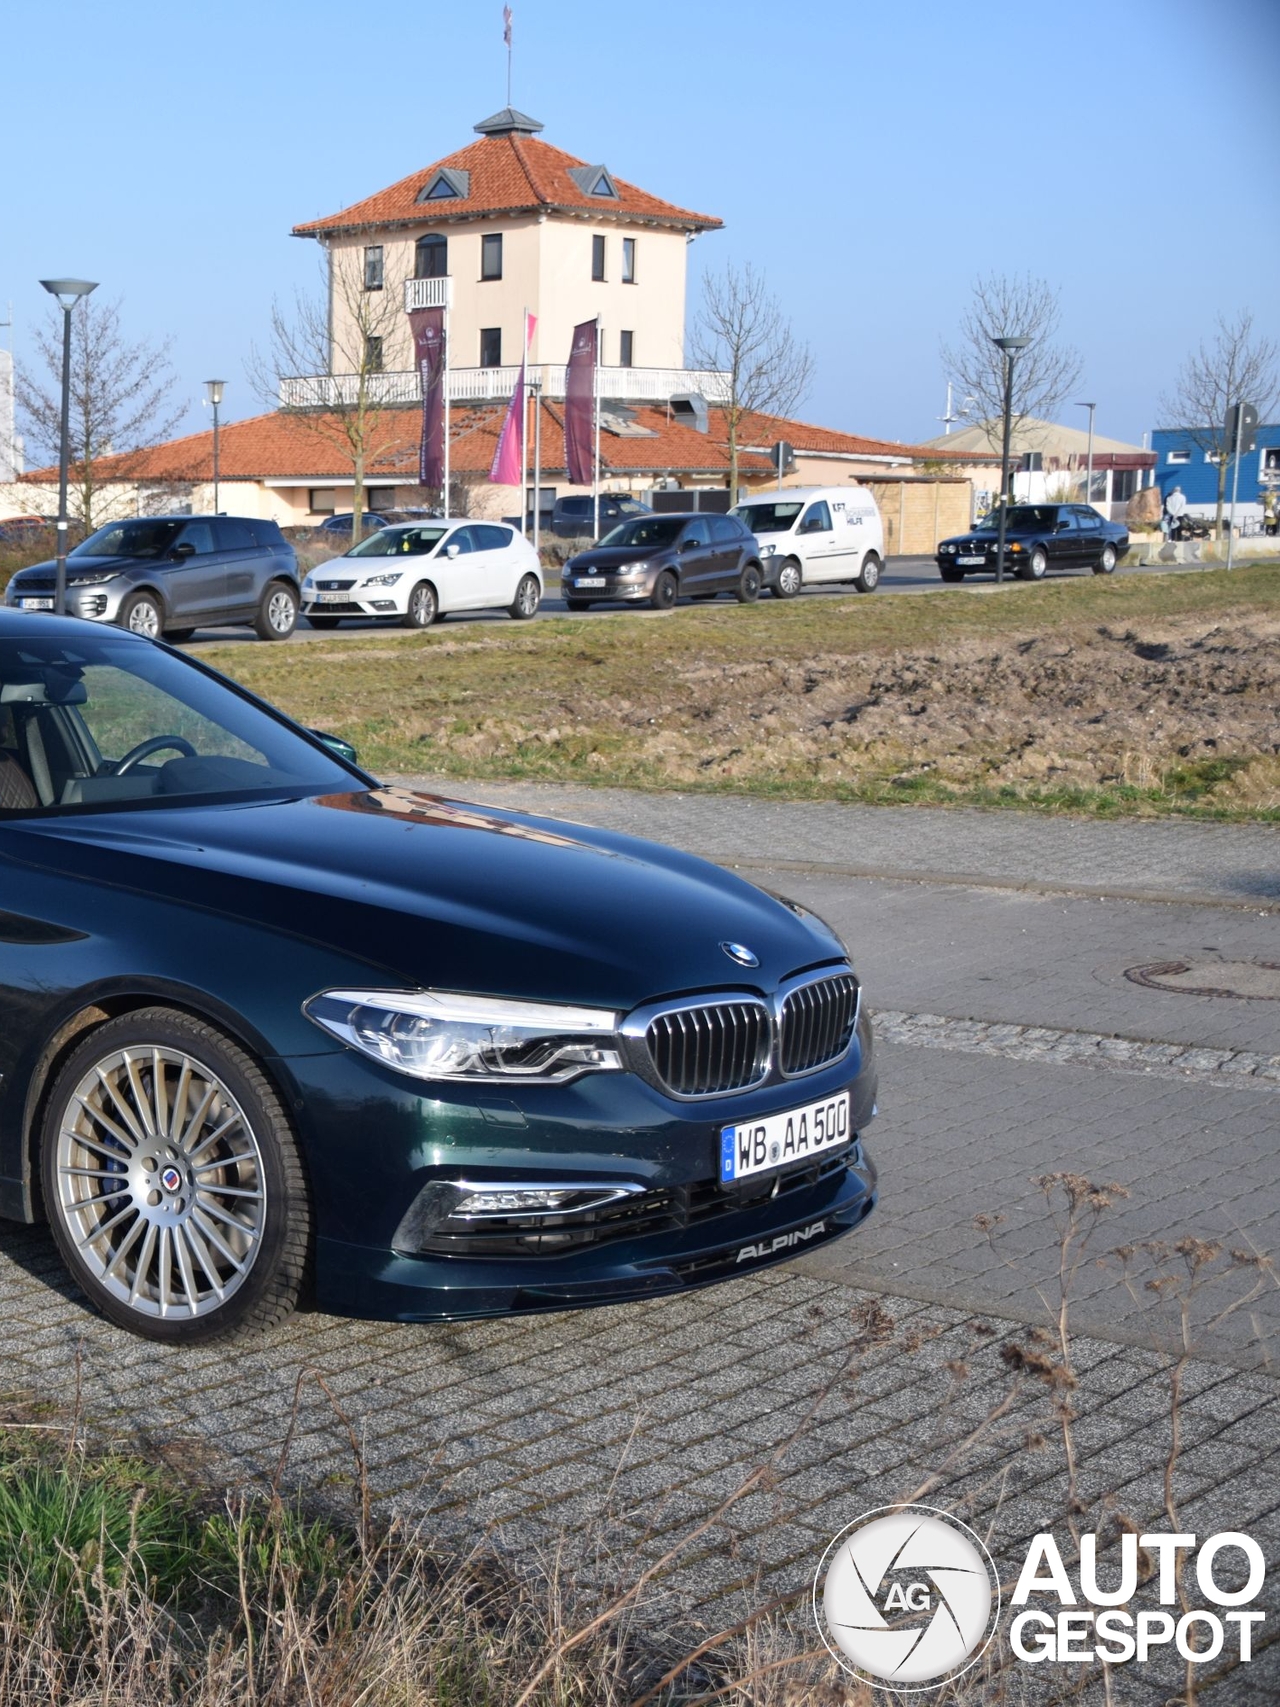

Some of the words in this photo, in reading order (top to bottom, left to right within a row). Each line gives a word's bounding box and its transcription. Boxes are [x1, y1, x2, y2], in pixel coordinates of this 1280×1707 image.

[738, 1126, 767, 1171] WB
[783, 1113, 808, 1158] AA
[814, 1099, 847, 1146] 500
[735, 1220, 825, 1264] ALPINA
